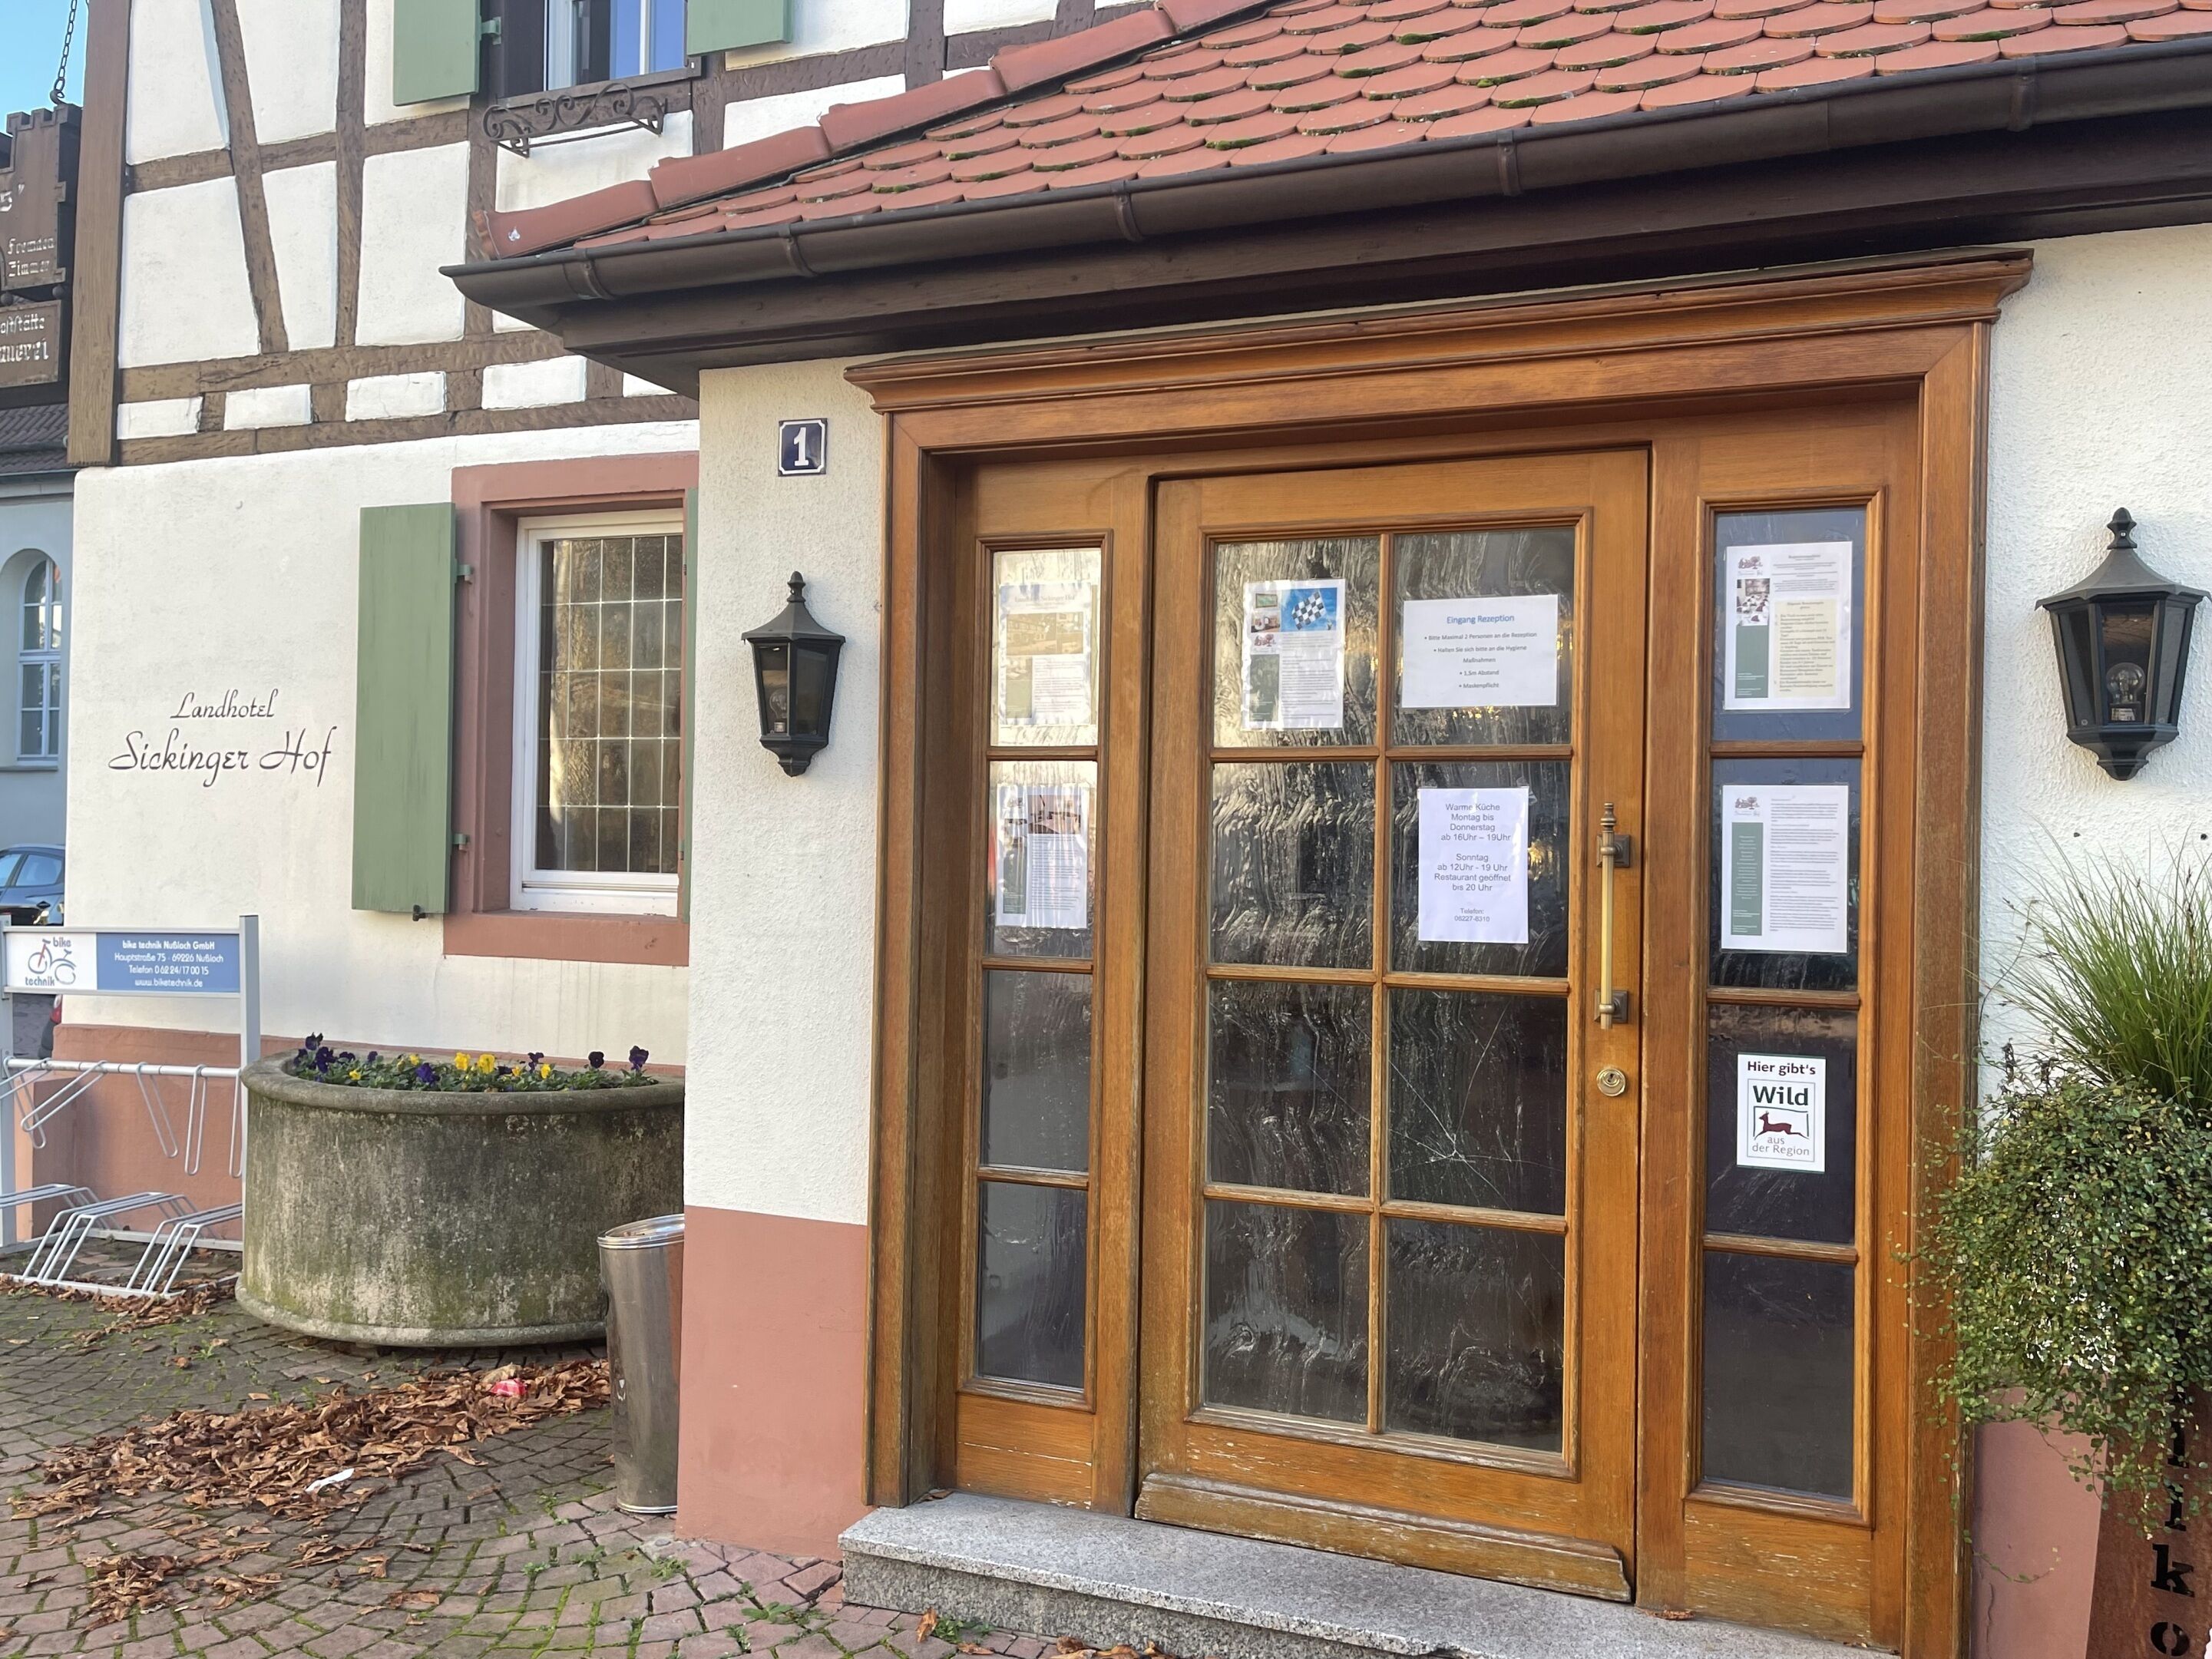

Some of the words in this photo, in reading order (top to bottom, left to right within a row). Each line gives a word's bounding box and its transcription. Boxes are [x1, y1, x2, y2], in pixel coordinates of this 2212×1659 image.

[793, 427, 809, 466] 1
[1447, 616, 1476, 625] Eingang
[1477, 615, 1515, 623] Rezeption
[170, 689, 279, 719] Landhotel
[107, 728, 250, 788] Sickinger
[259, 726, 337, 788] Hof
[1451, 814, 1480, 822] Montag
[1450, 824, 1496, 832] Donnerstag
[1456, 854, 1489, 862] Sonntag
[1479, 874, 1511, 883] geöffnet
[53, 937, 71, 947] bike
[123, 940, 137, 949] bike
[138, 940, 162, 950] technik
[163, 940, 191, 950] Nußloch
[193, 941, 215, 950] GmbH
[114, 953, 156, 963] Hauptstraße
[157, 953, 166, 962] 75
[171, 953, 194, 963] 69226
[196, 954, 223, 963] Nußloch
[129, 965, 154, 973] Telefon
[25, 976, 55, 986] technik
[134, 978, 203, 987] www.biketechnik.de
[1747, 1061, 1775, 1072] Hier
[1778, 1062, 1816, 1076] gibt's
[1753, 1085, 1808, 1105] Wild
[1767, 1136, 1785, 1145] aus
[1752, 1143, 1769, 1152] der
[1773, 1145, 1810, 1156] Region
